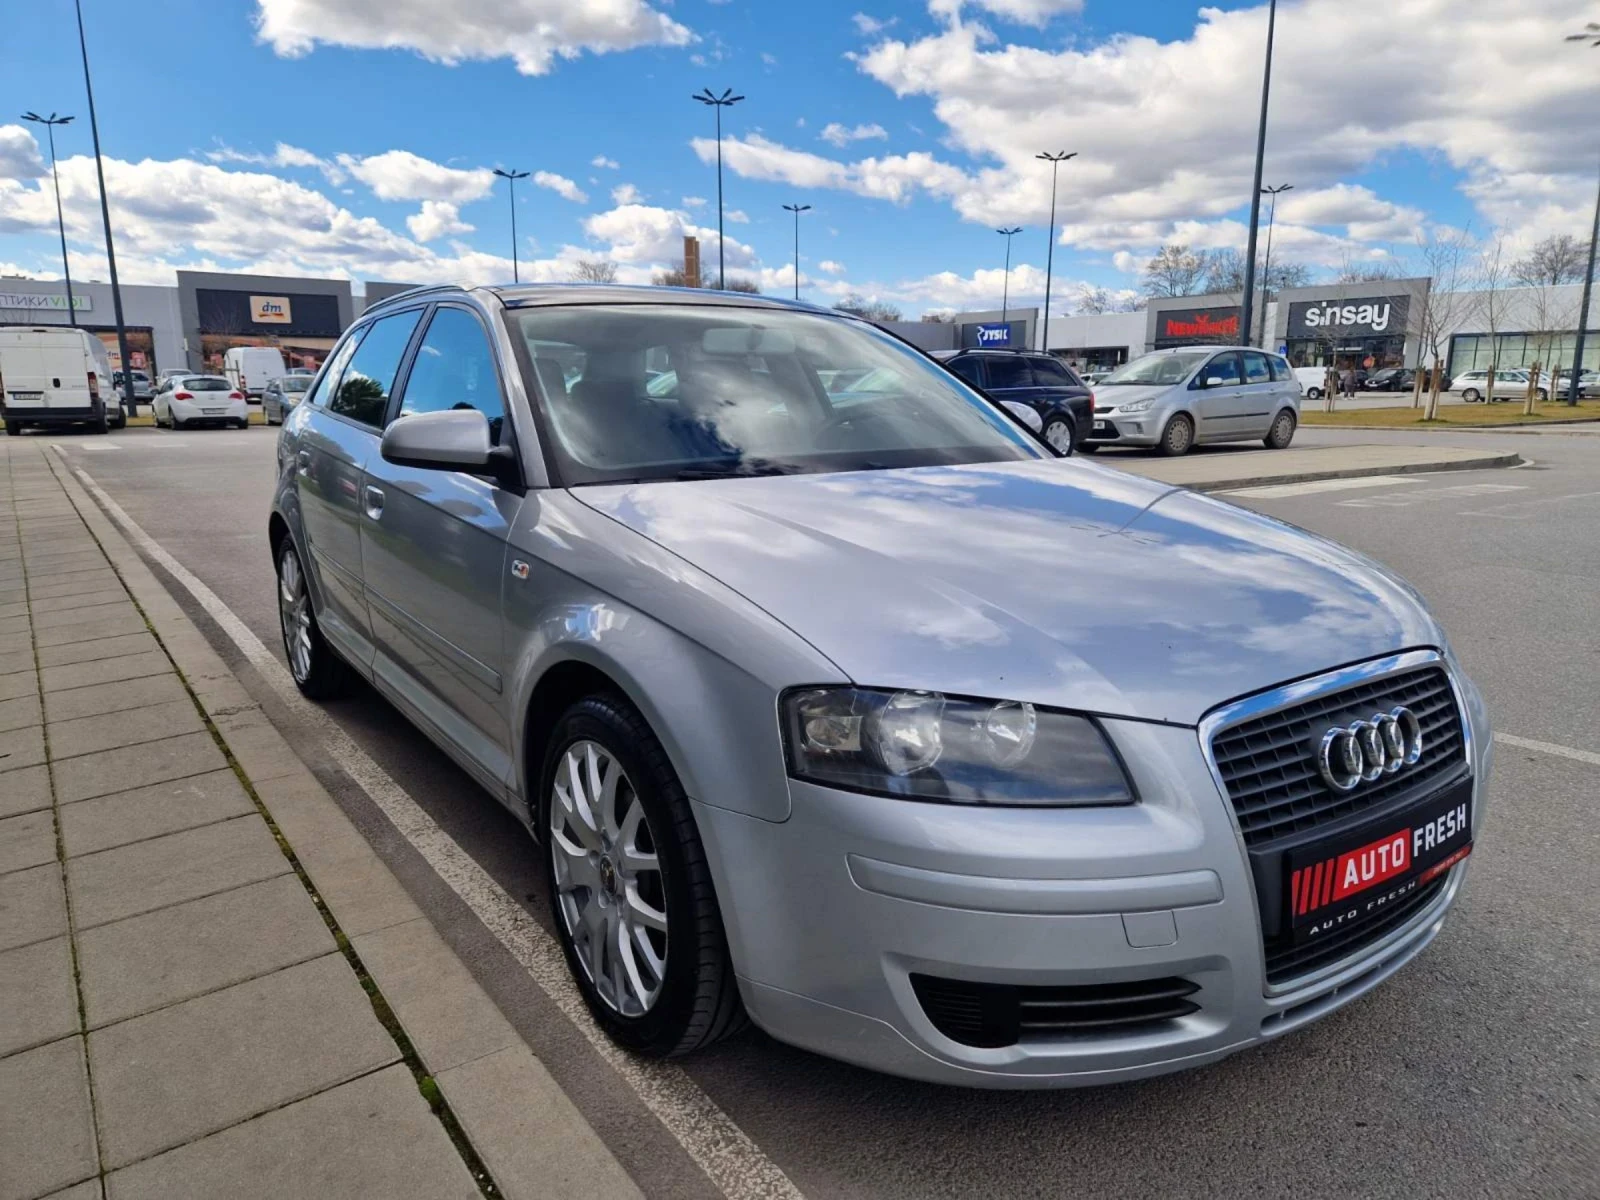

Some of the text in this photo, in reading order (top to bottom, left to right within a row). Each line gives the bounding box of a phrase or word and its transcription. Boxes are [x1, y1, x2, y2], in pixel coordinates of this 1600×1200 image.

[262, 301, 282, 312] dm
[1305, 301, 1391, 331] sinsay
[982, 329, 1009, 341] JYSK
[1343, 837, 1405, 889] AUTO
[1413, 802, 1467, 857] FRESH
[1309, 880, 1416, 935] AUTO FRESH
